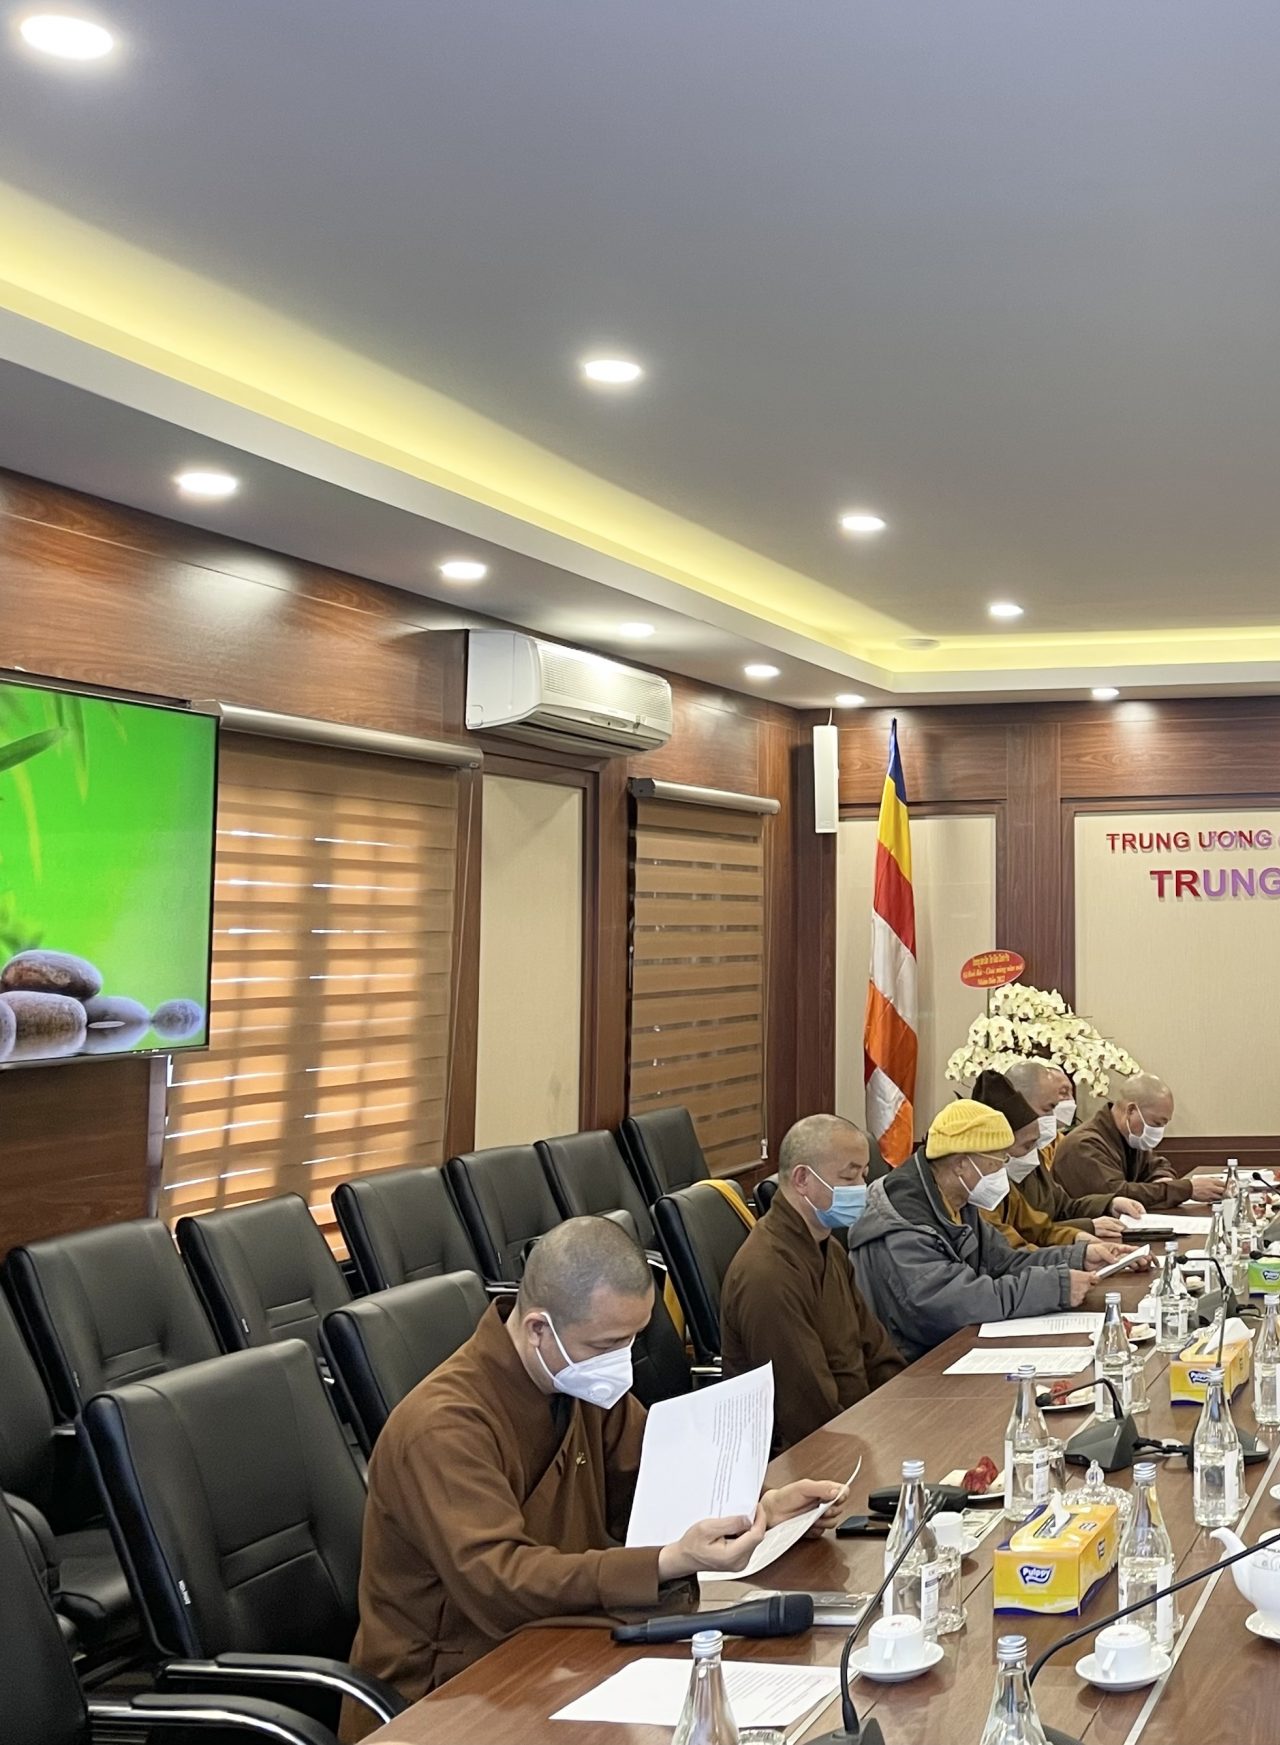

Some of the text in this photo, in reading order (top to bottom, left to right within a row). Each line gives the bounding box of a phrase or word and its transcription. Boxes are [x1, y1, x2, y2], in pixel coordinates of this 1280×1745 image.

[1106, 831, 1190, 852] TRUNG
[1198, 829, 1272, 850] ƯƠNG
[1022, 1566, 1051, 1580] Pulppy
